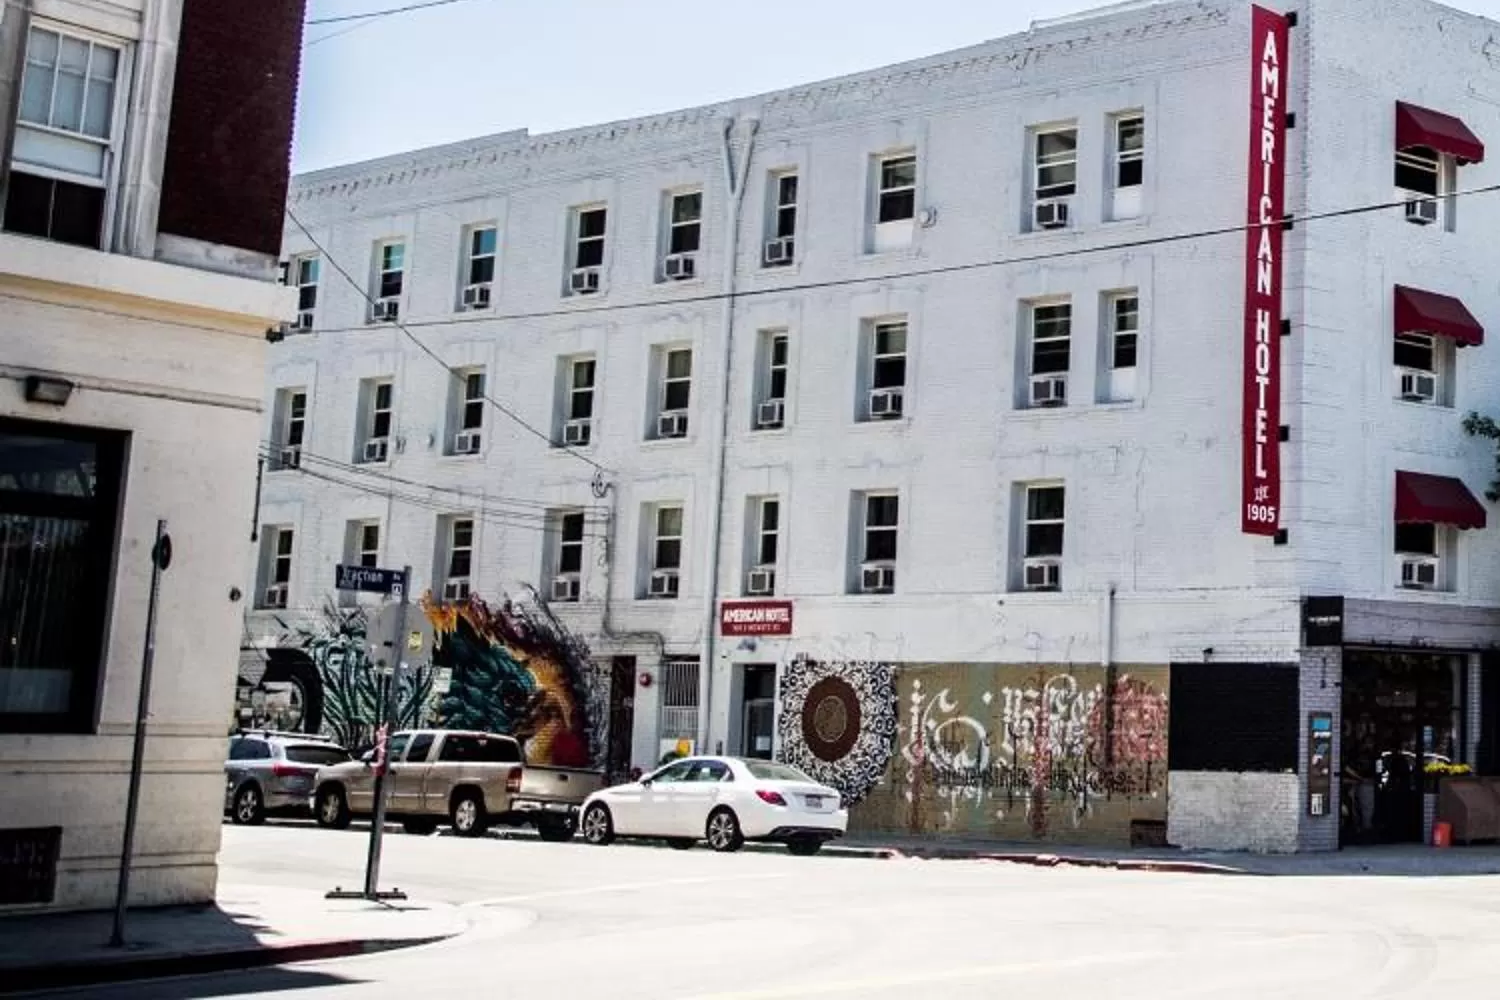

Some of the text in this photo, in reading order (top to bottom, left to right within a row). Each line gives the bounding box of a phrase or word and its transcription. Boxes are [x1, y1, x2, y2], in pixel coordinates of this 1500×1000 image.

[1256, 30, 1279, 296] AMERICAN
[1254, 309, 1271, 479] HOTEL
[1247, 503, 1276, 523] 1905
[723, 608, 764, 623] AMERICAN
